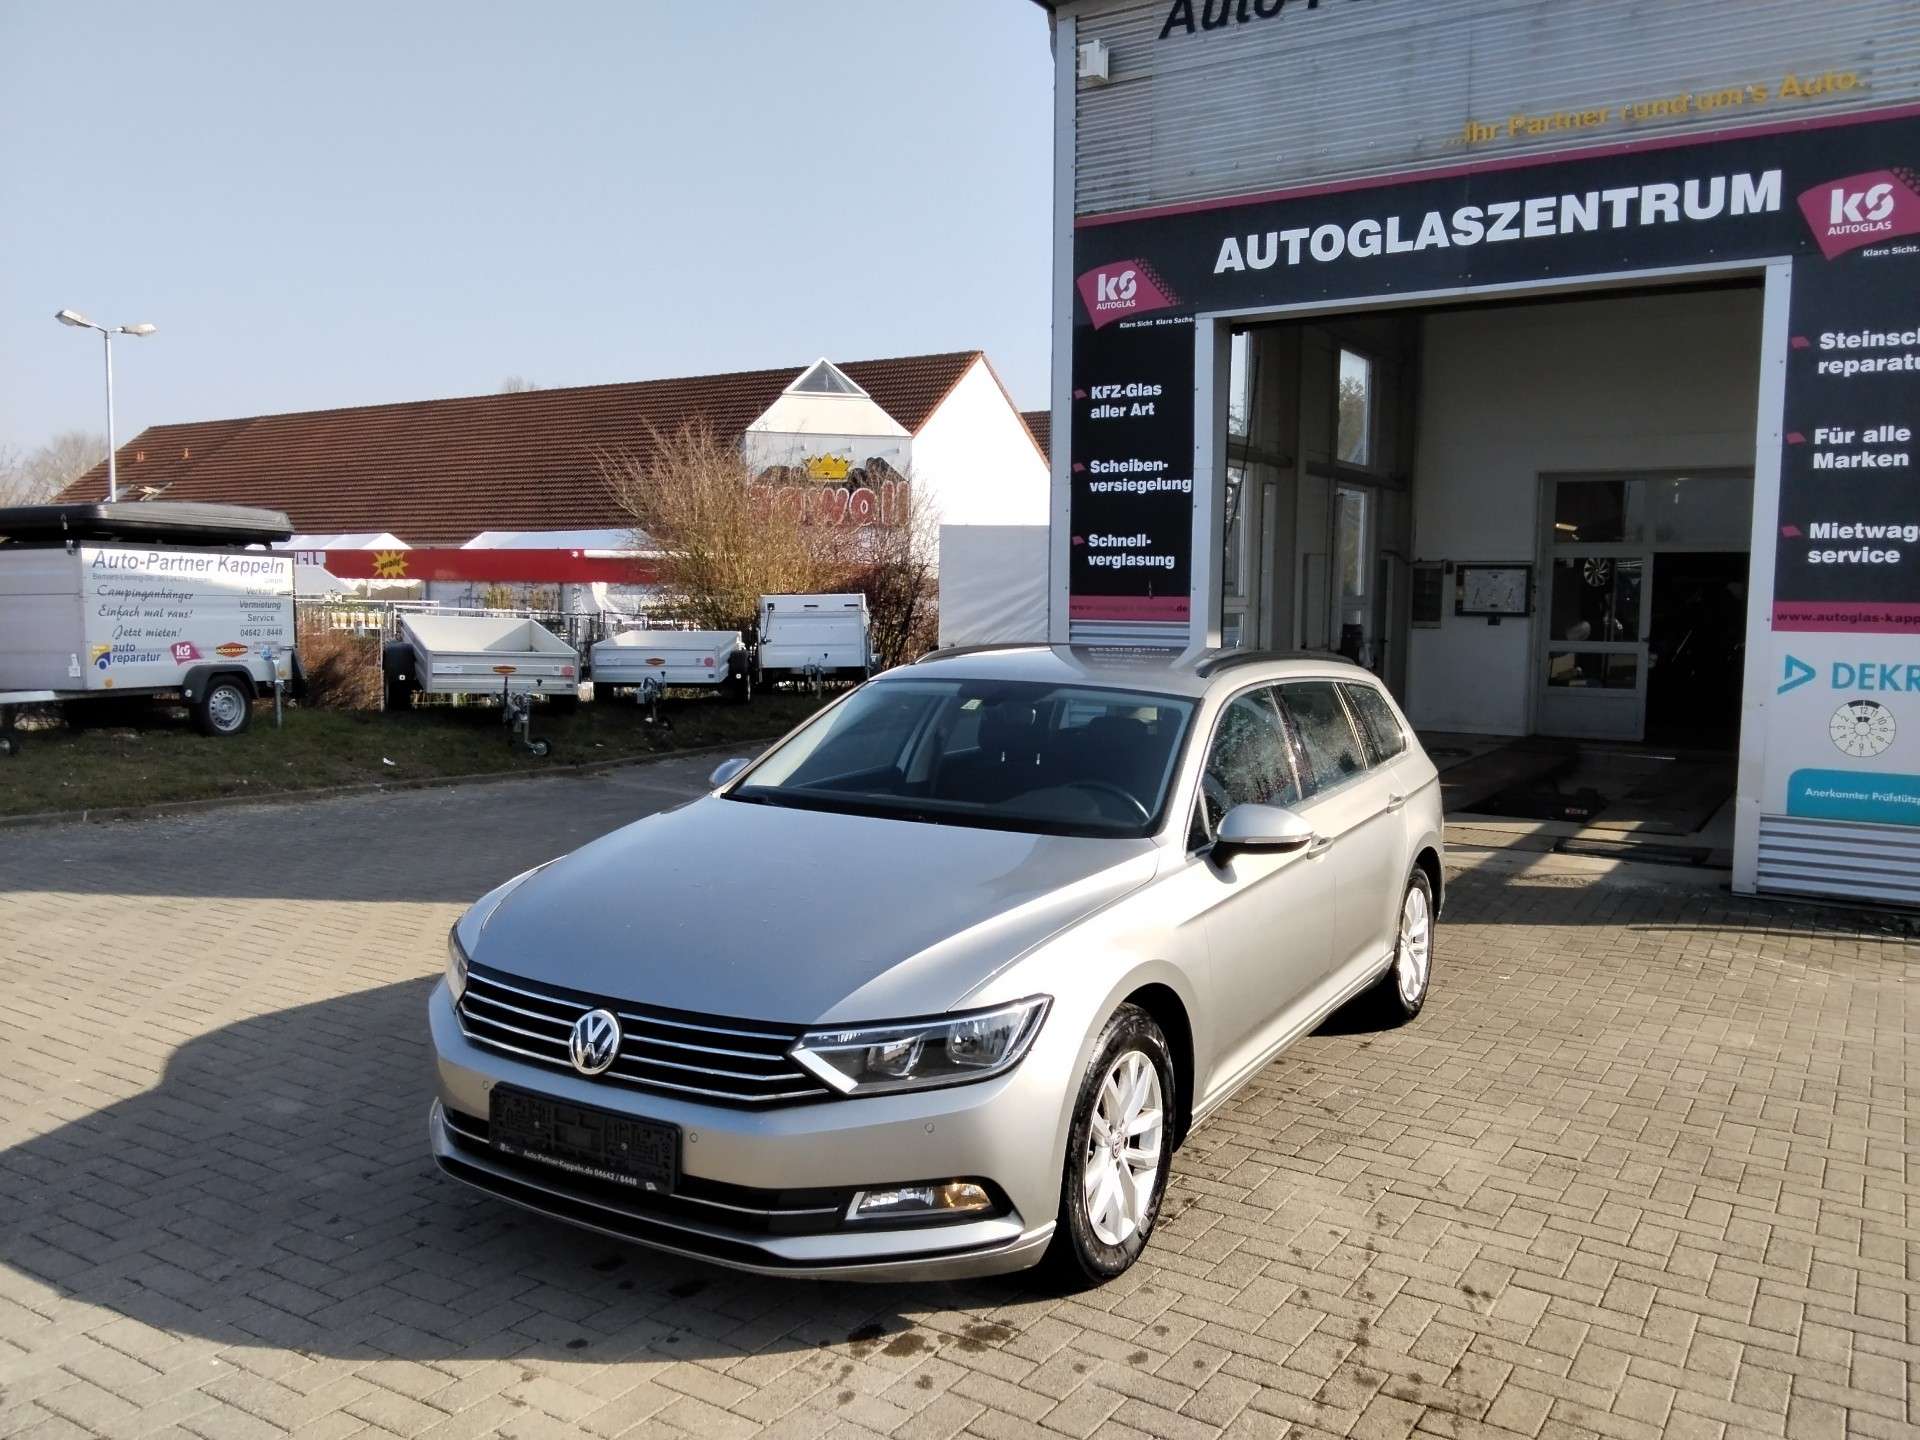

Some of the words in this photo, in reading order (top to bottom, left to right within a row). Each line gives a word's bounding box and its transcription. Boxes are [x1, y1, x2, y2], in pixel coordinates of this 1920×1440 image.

[1507, 108, 1610, 140] Partner
[1620, 92, 1689, 122] rund
[1213, 170, 1783, 275] AUTOGLASZENTRUM
[1827, 220, 1893, 237] AUTOGLAS
[1863, 249, 1890, 257] Klare
[1096, 299, 1137, 311] AUTOGLAS
[1155, 318, 1173, 326] Klare
[1819, 327, 1920, 351] Steinsc
[1090, 382, 1163, 400] KFZ-Glas
[1090, 403, 1126, 420] aller
[1130, 402, 1156, 418] Art
[1813, 427, 1856, 446] Für
[1862, 424, 1912, 444] alle
[1089, 459, 1170, 475] Scheiben-
[1812, 450, 1910, 470] Marken
[1089, 476, 1193, 494] versiegelung
[1088, 533, 1152, 549] Schnell-
[92, 550, 213, 572] Auto-Partner
[217, 556, 285, 577] Kappeln
[1087, 553, 1176, 571] verglasung
[1807, 546, 1901, 564] service
[97, 584, 194, 602] Campinganhänger
[97, 604, 140, 621] Einfach
[144, 608, 164, 618] mal
[167, 609, 193, 619] raus!
[247, 613, 275, 622] Service
[112, 624, 142, 640] Jetzt
[112, 643, 136, 653] auto
[112, 651, 161, 665] reparatur
[1805, 787, 1869, 800] Anerkannter
